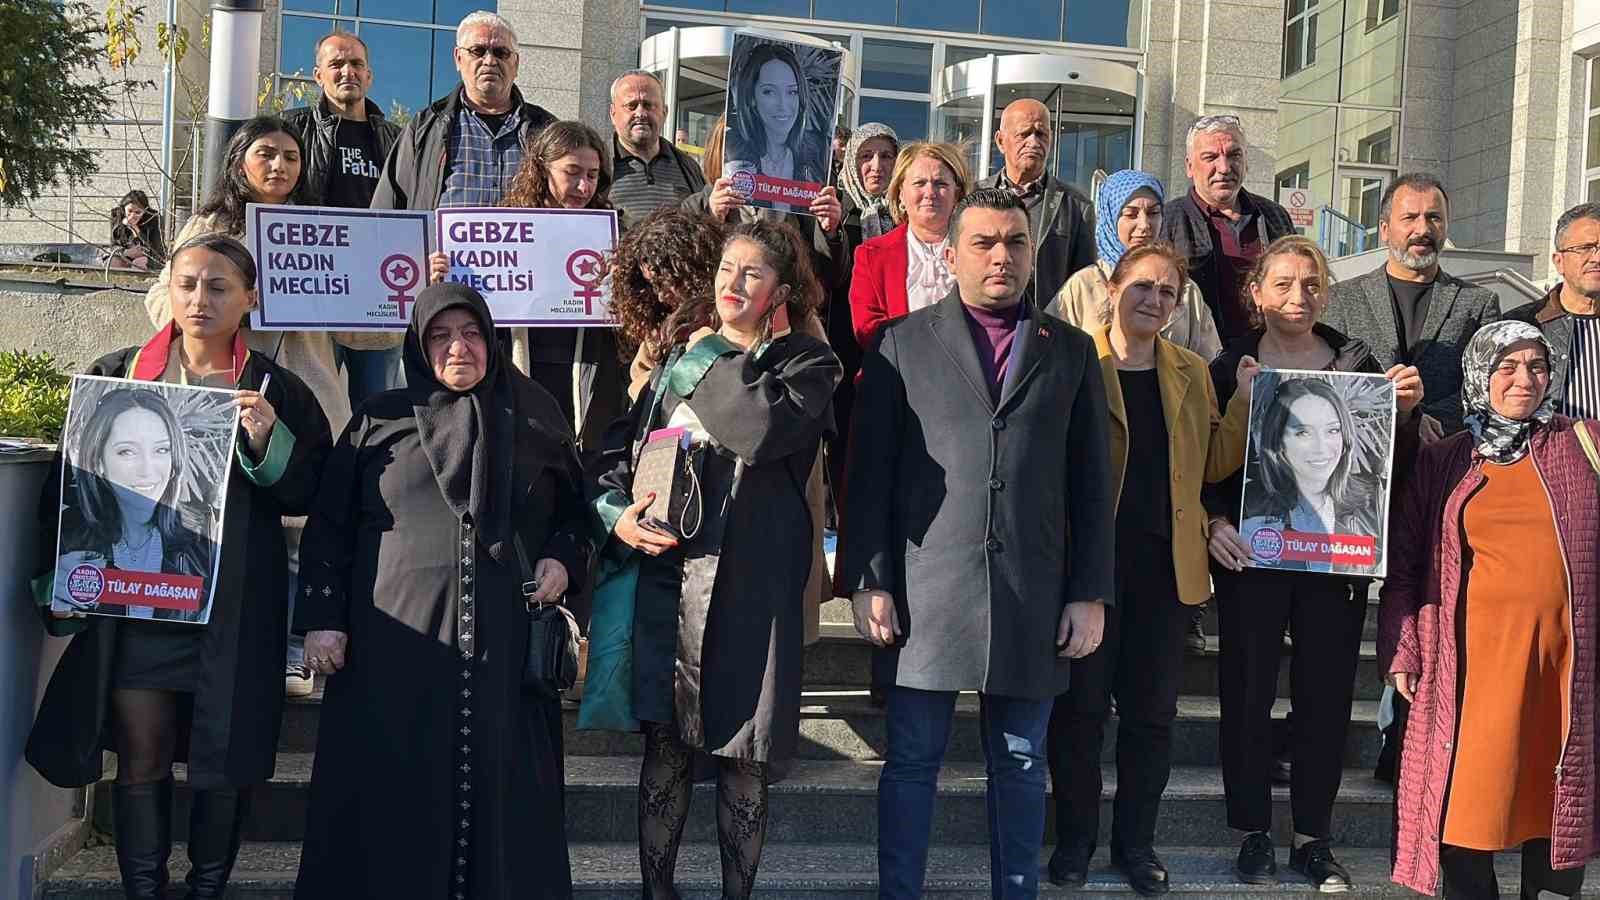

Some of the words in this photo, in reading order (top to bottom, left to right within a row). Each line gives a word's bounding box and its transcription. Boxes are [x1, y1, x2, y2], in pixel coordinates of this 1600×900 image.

[339, 146, 362, 159] THE
[342, 158, 380, 178] Fath
[758, 182, 781, 194] TÜLAY
[267, 222, 350, 247] GEBZE
[448, 221, 535, 243] GEBZE
[268, 252, 334, 271] KADIN
[450, 250, 518, 268] KADIN
[269, 273, 350, 295] MECLİSİ
[451, 270, 533, 291] MECLİSİ
[1286, 539, 1318, 552] TÜLAY
[1321, 541, 1371, 556] DAĞAŞAN
[107, 579, 142, 595] TÜLAY
[144, 582, 198, 600] DAĞAŞAN
